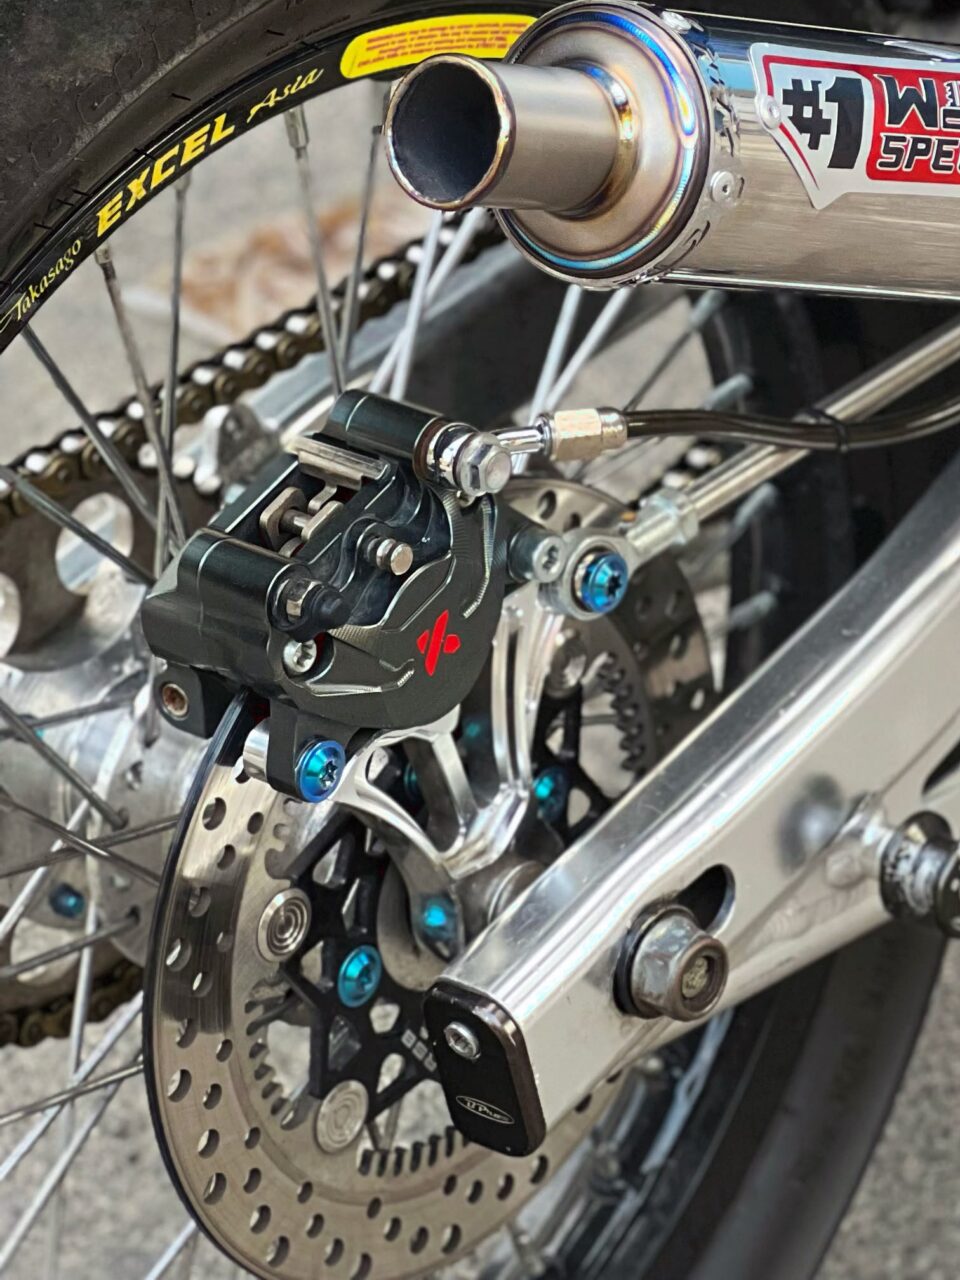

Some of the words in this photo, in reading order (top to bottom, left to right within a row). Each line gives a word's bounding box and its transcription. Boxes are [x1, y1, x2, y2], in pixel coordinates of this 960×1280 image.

[0, 238, 82, 333] Takasago
[96, 113, 236, 238] EXCEL
[246, 68, 324, 124] Asia
[782, 75, 865, 170] #1
